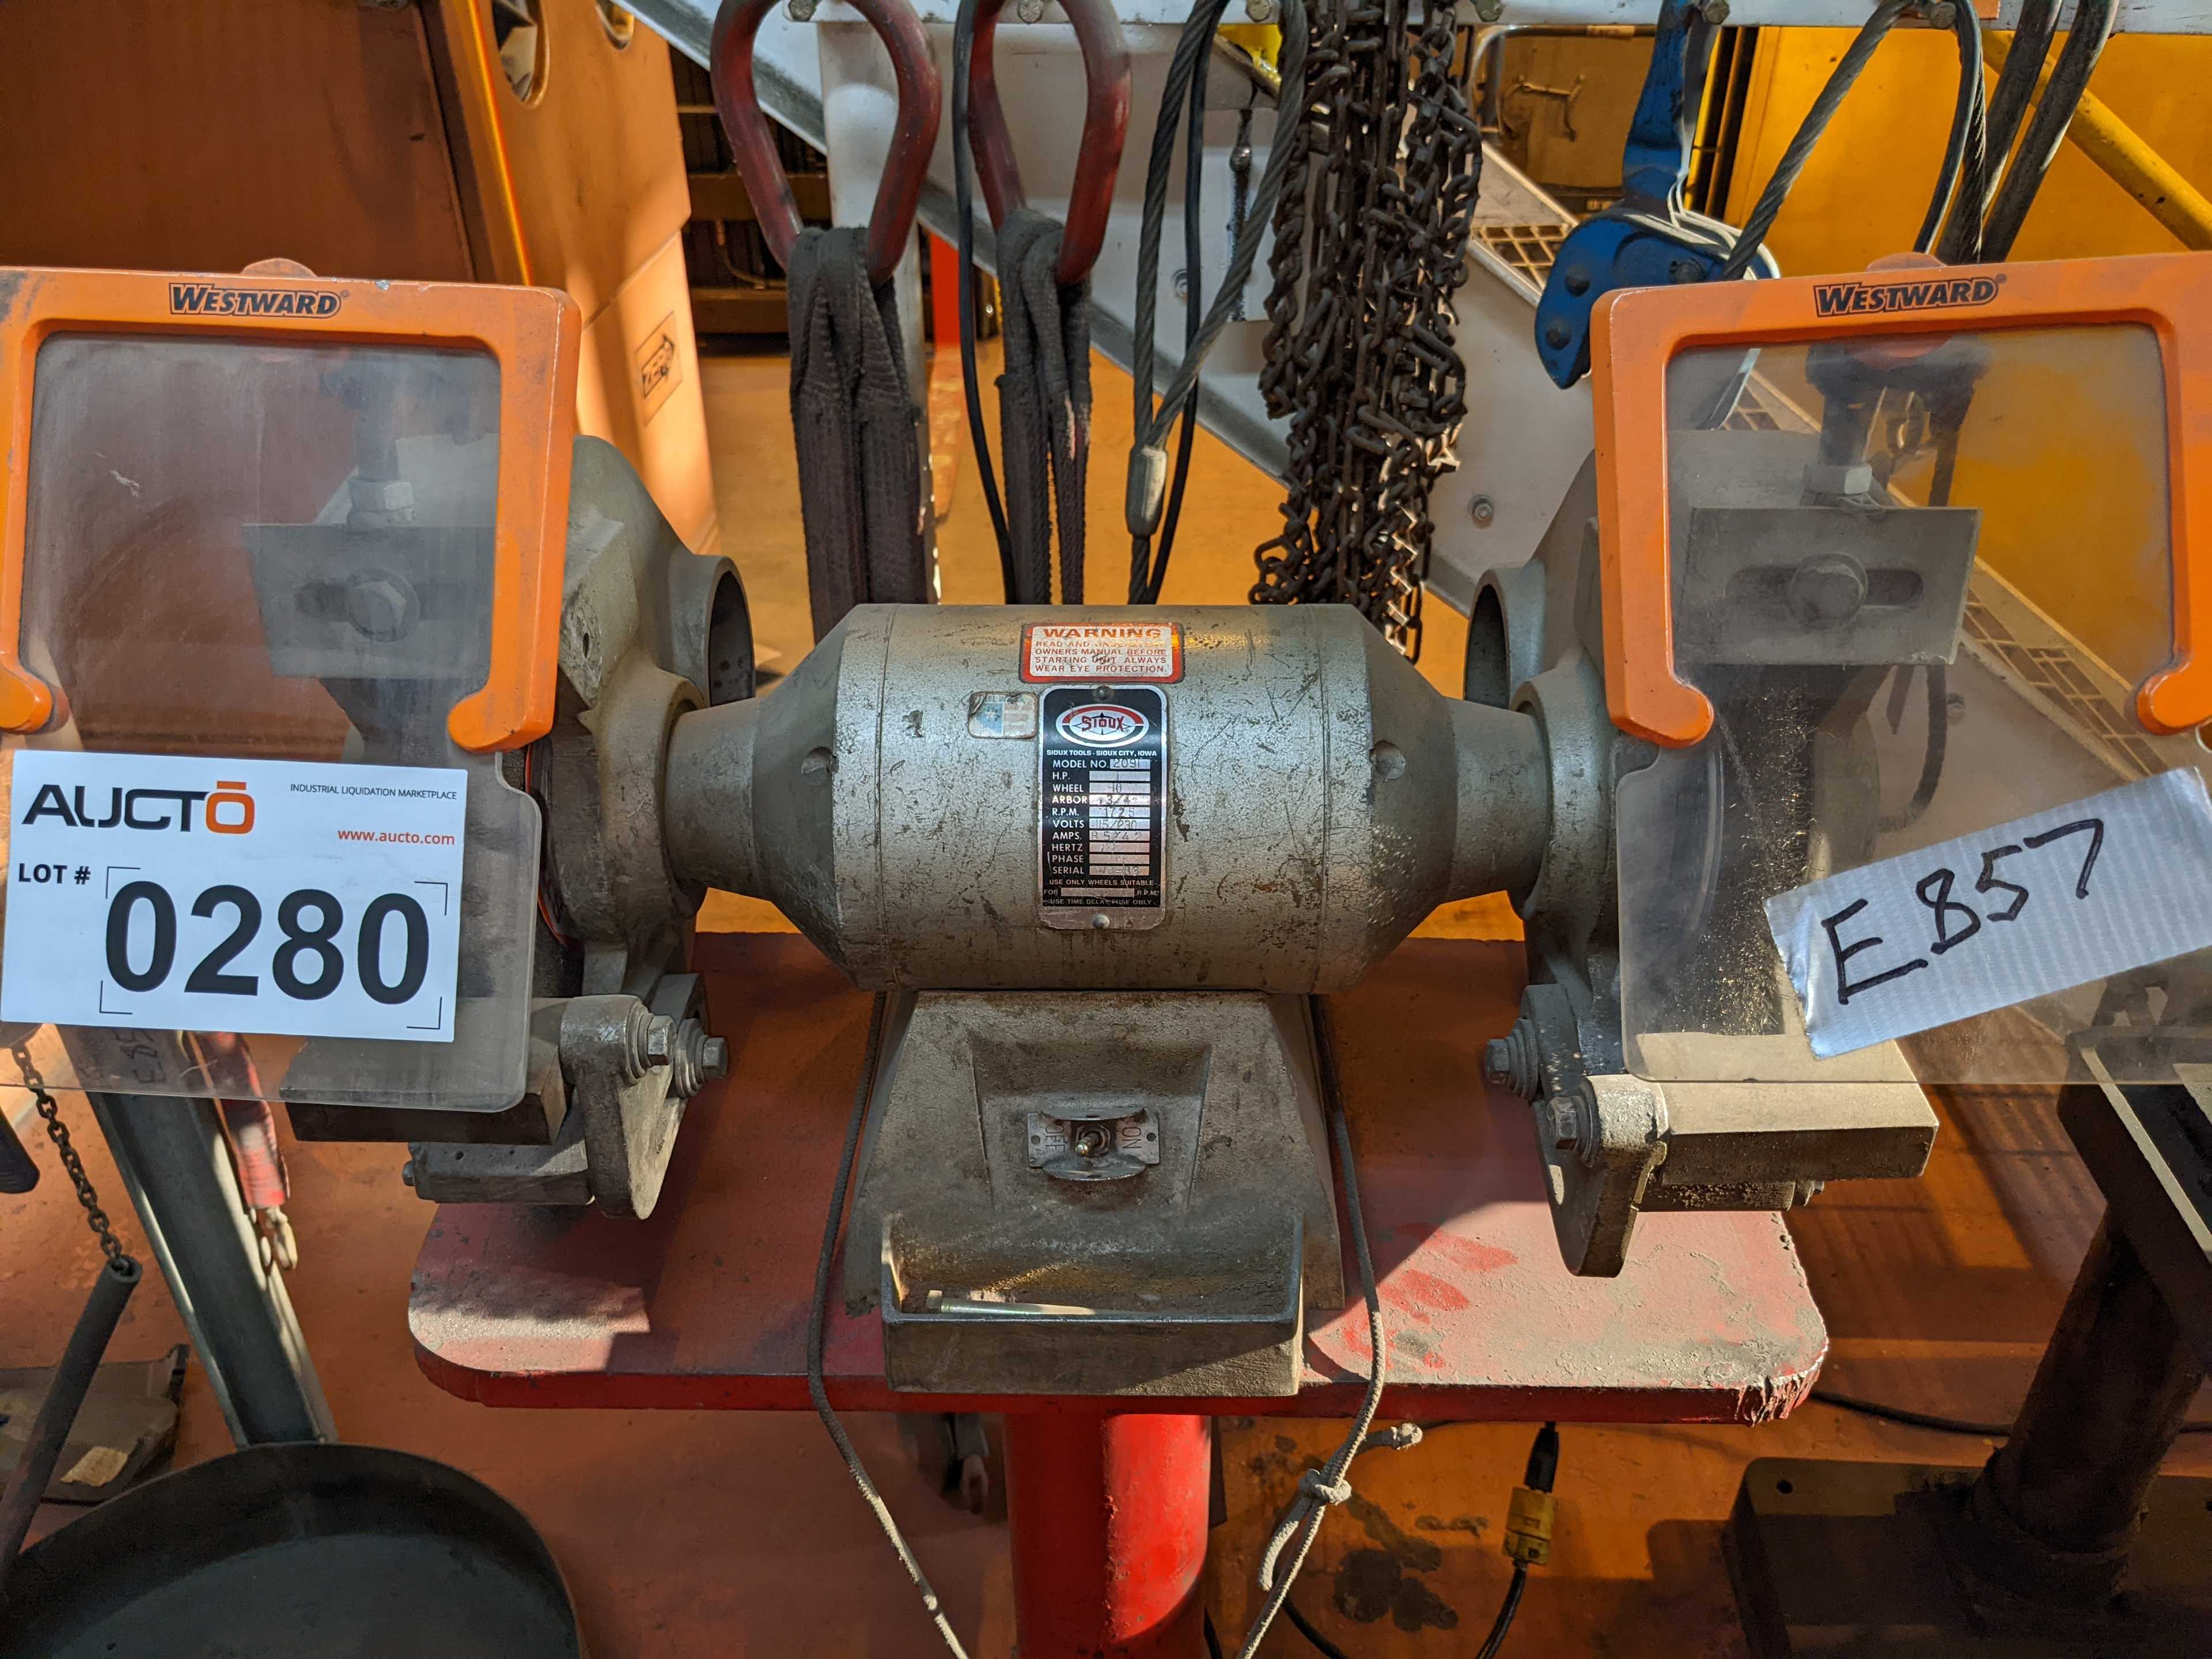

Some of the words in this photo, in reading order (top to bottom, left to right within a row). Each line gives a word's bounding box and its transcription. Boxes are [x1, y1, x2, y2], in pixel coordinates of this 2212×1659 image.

[169, 283, 342, 318] WESTWARD
[1813, 276, 1999, 317] WESTWARD
[1043, 628, 1162, 638] WARNING
[1082, 715, 1124, 732] SIOUX
[1052, 760, 1086, 768] MODEL
[290, 783, 339, 794] INDUSTRIAL
[342, 786, 396, 797] LIQUIDATION
[398, 789, 457, 800] MARKETPLACE
[1052, 784, 1084, 792] WHEEL
[1052, 796, 1087, 804] ARBOR
[1052, 820, 1084, 828] VOLTS
[338, 830, 455, 845] www.aucto.com
[18, 863, 67, 884] LOT
[104, 879, 430, 1006] 0280
[1046, 1124, 1065, 1152] OFF
[1122, 1127, 1142, 1149] ON
